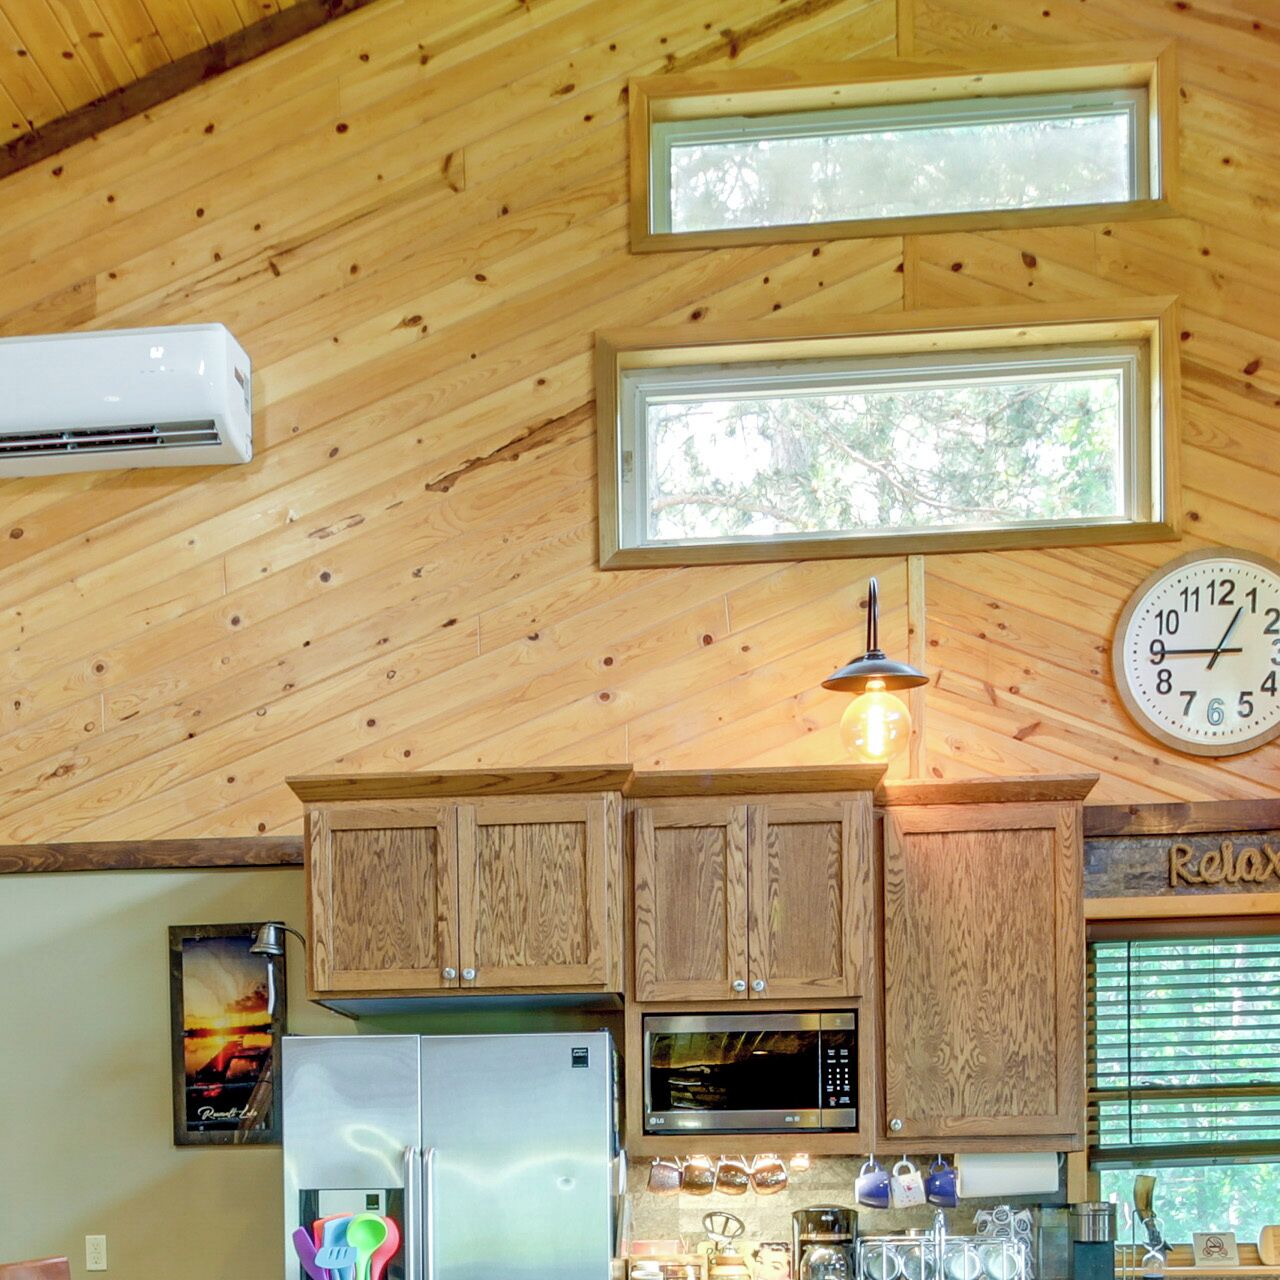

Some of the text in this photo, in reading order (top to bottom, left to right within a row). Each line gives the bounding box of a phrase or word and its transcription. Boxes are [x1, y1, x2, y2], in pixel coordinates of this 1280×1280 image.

[1179, 586, 1200, 612] 11
[1206, 579, 1236, 606] 12
[1245, 587, 1257, 614] 1
[1154, 609, 1180, 635] 10
[1149, 639, 1166, 665] 9
[1155, 668, 1173, 695] 8
[1260, 670, 1278, 697] 4
[1179, 691, 1197, 717] 7
[1206, 698, 1225, 726] 6
[1237, 691, 1254, 718] 5
